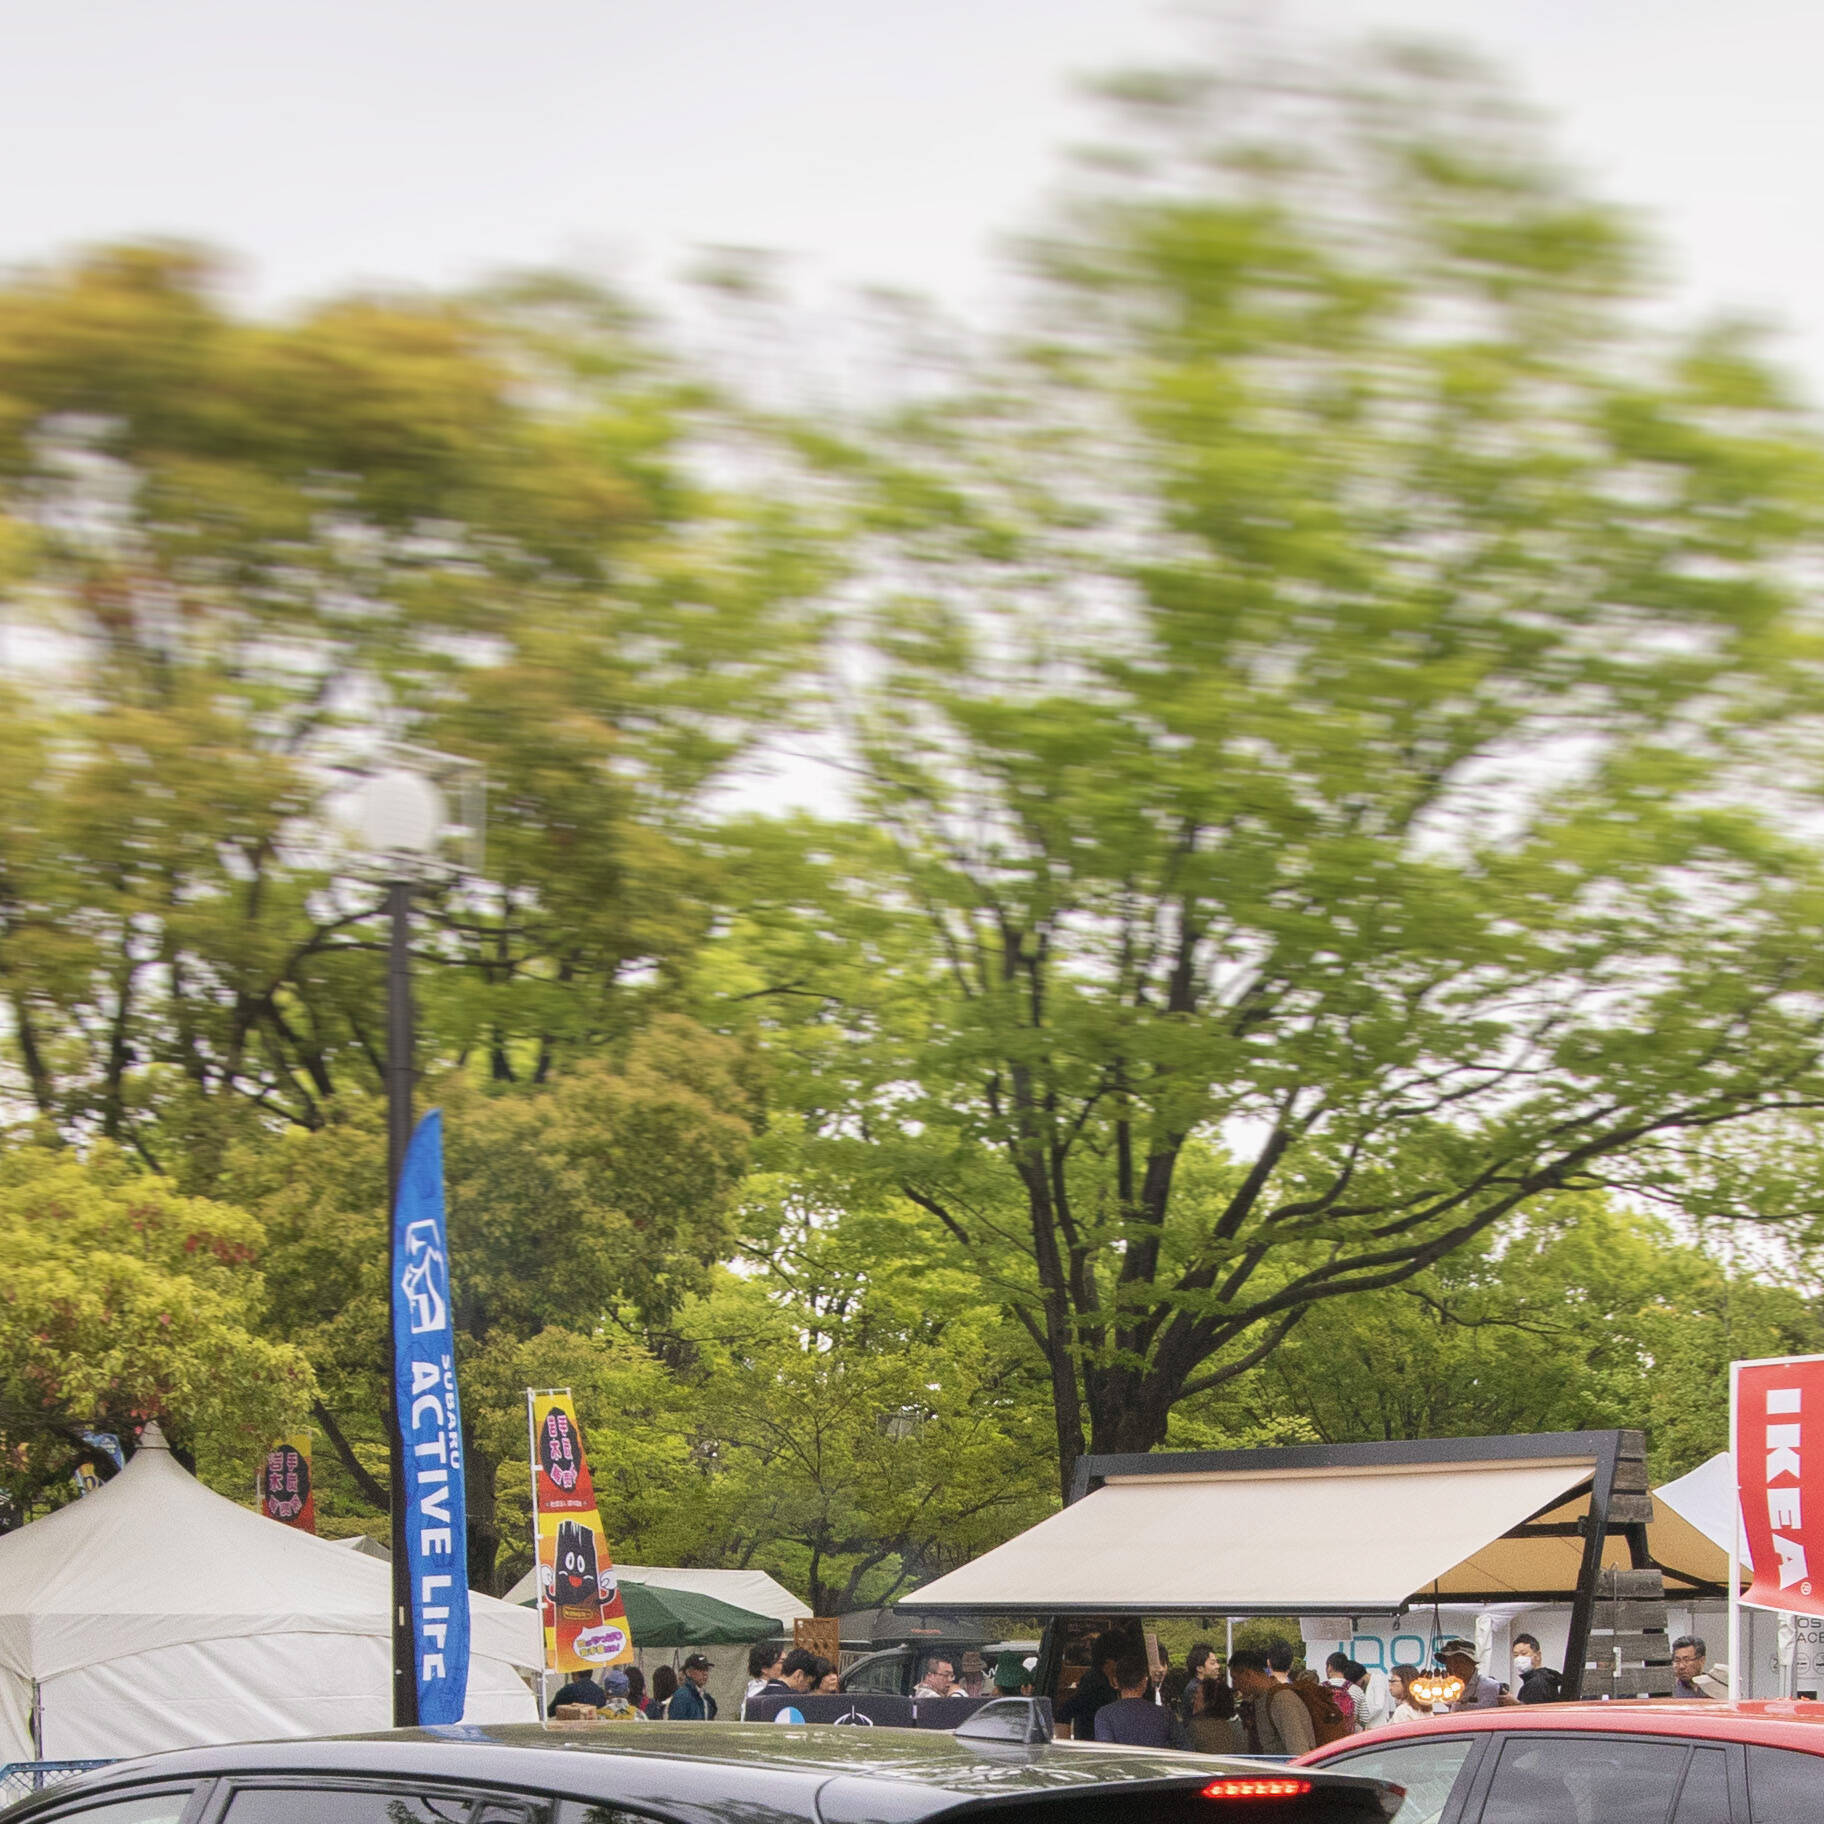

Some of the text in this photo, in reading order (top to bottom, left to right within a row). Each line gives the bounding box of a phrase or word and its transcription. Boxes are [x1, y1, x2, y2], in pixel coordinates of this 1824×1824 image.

[441, 1353, 461, 1470] SUBARU
[1765, 1388, 1809, 1591] IKEA
[410, 1360, 453, 1681] ACTIVE LIFE
